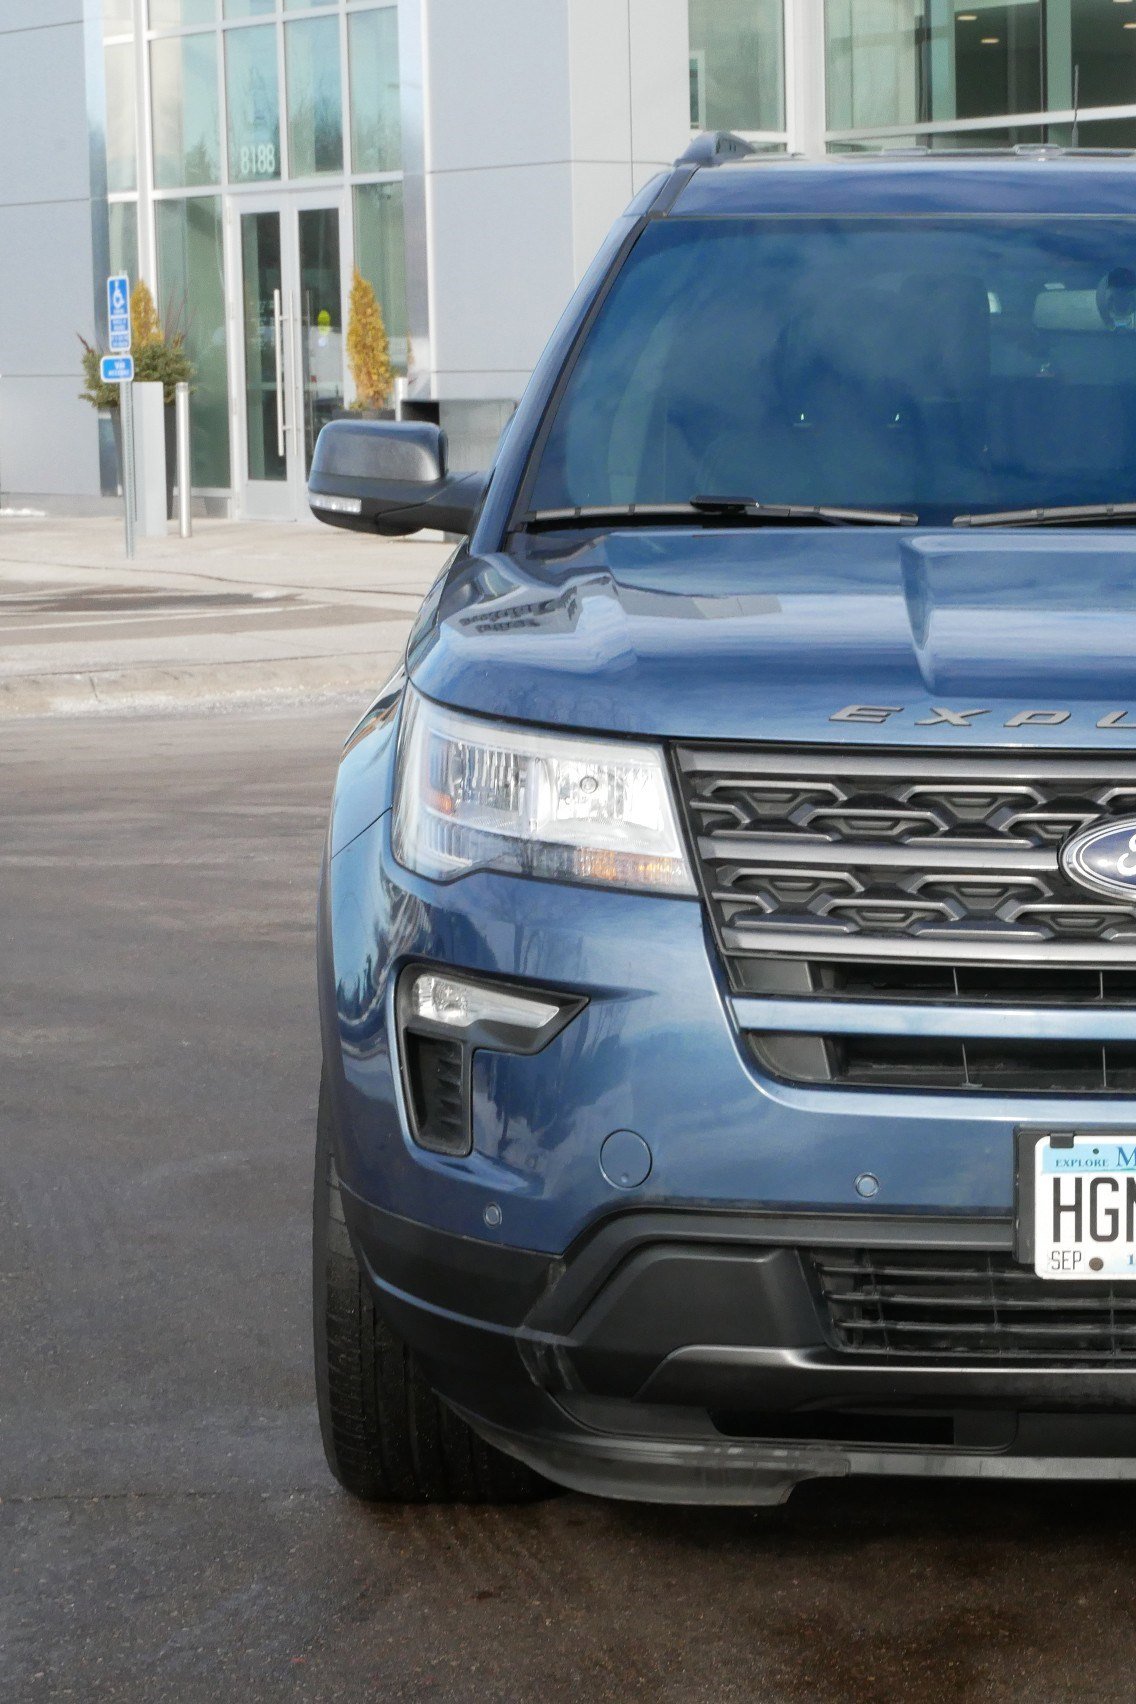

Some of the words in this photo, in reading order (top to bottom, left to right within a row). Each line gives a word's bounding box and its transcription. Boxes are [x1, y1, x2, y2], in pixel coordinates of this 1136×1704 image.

[240, 143, 275, 174] 8188
[1055, 1159, 1109, 1168] EXPLORE
[1050, 1250, 1082, 1271] SEP
